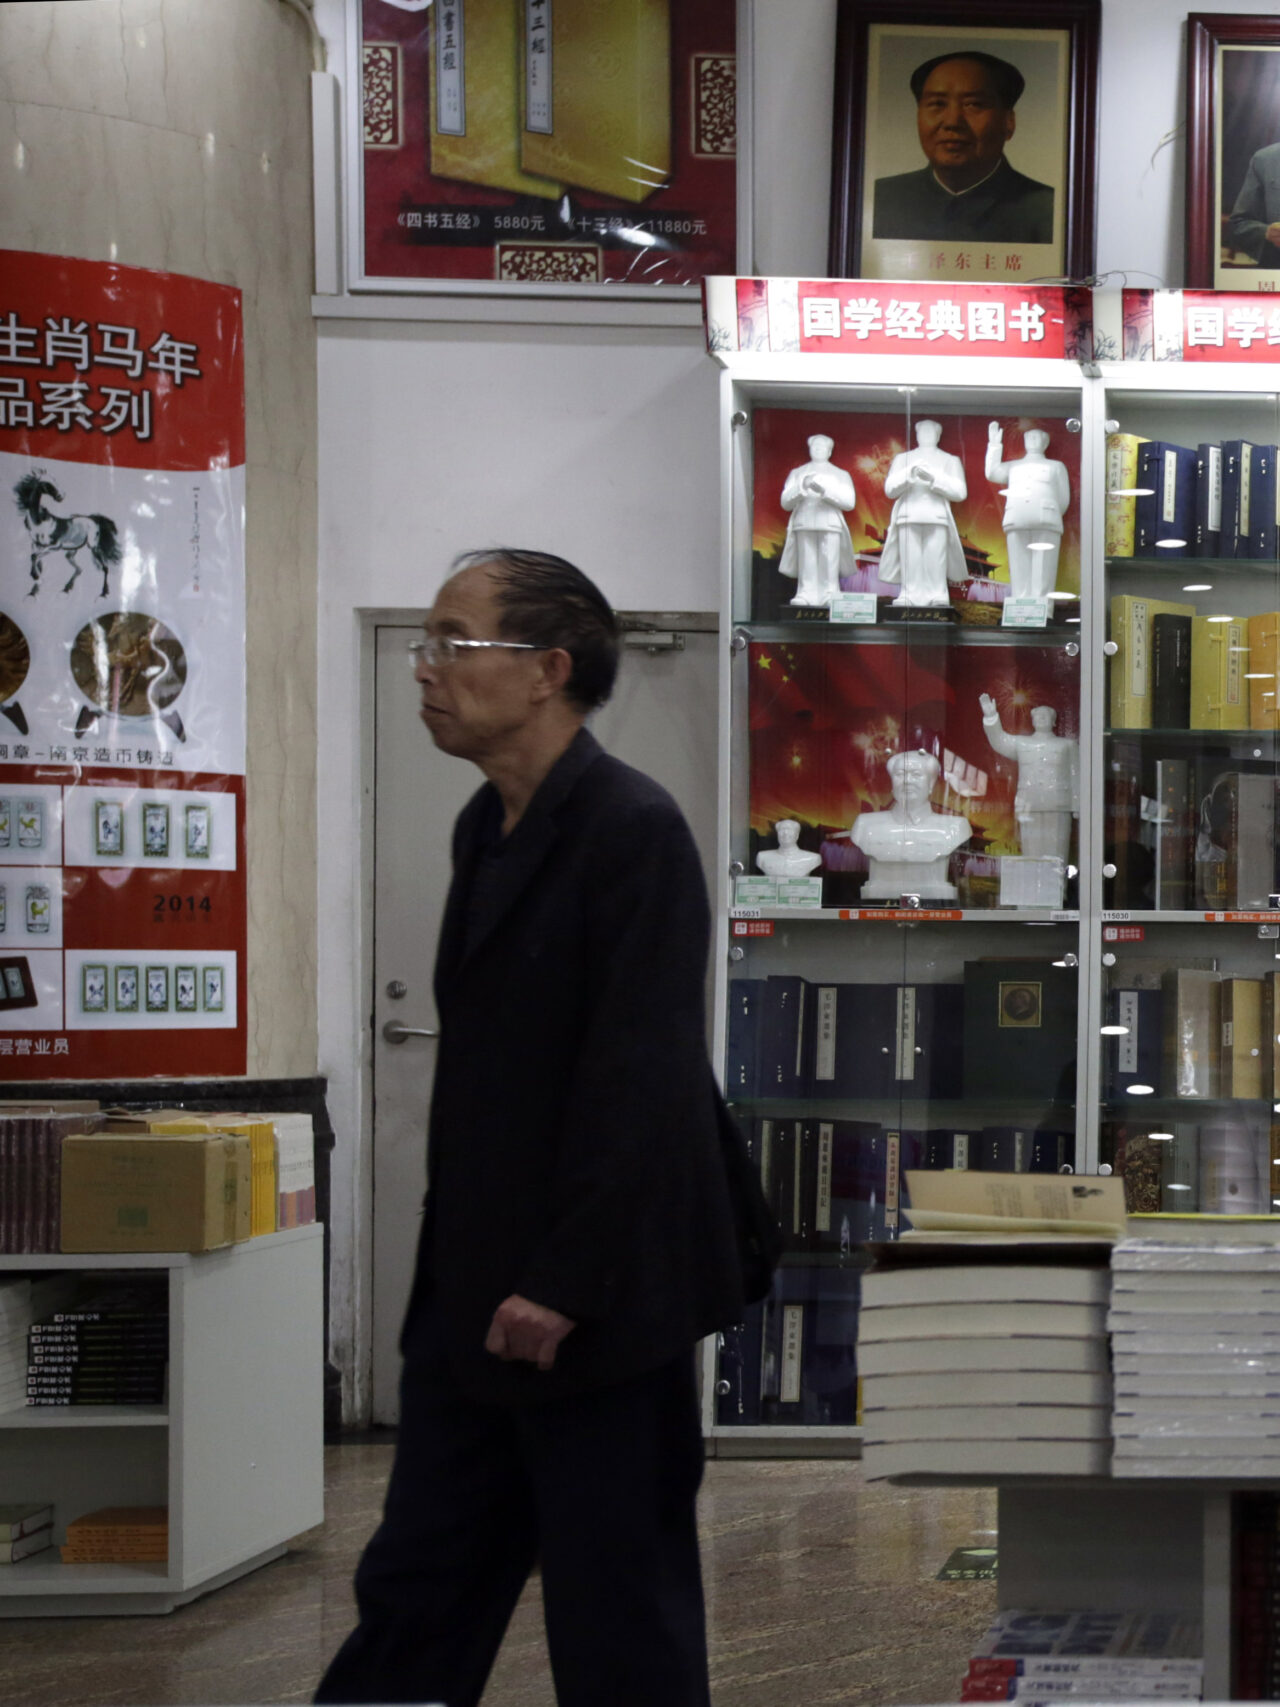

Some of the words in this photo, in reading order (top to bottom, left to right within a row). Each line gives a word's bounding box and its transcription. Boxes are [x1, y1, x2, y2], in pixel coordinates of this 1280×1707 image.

[494, 216, 546, 232] 5880元
[802, 298, 1046, 343] 国学经典图书
[0, 312, 201, 386] 生肖马年
[0, 377, 152, 439] 品系列
[153, 894, 212, 913] 2014
[733, 910, 760, 918] 115031
